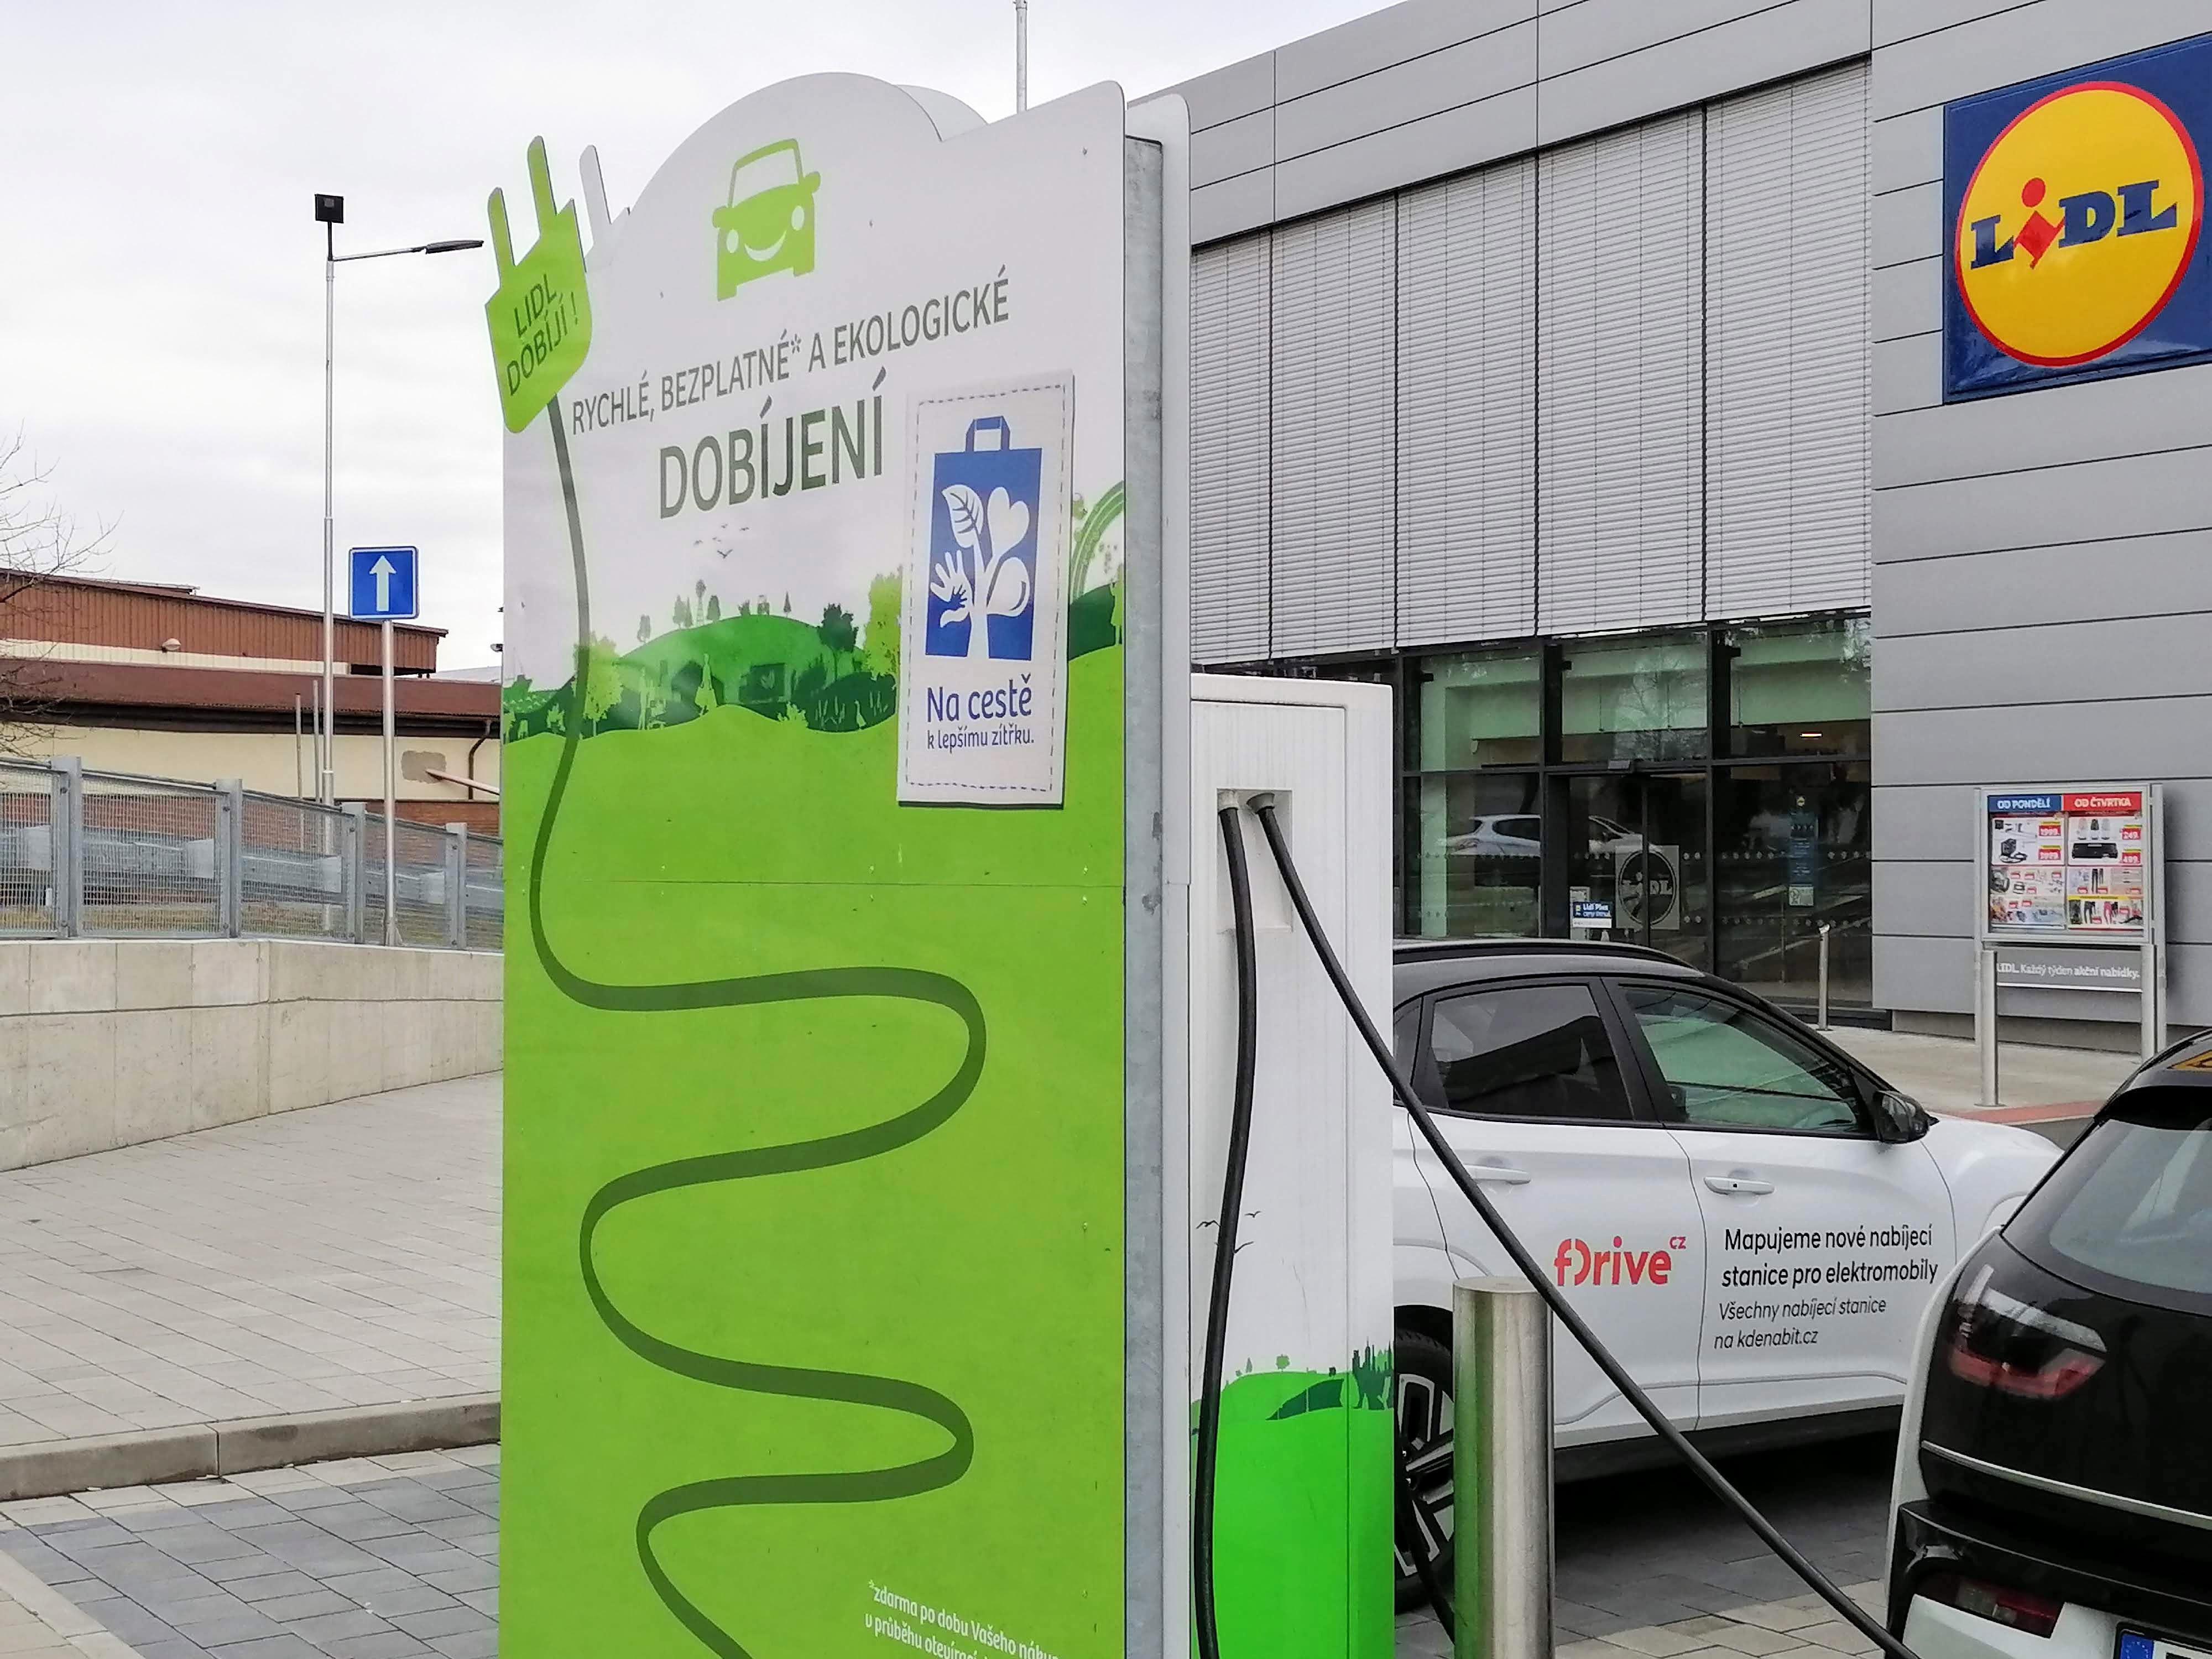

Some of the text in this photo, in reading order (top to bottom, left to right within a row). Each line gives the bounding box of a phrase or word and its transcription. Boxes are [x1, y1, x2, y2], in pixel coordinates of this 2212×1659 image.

[514, 274, 556, 338] LIDL
[573, 370, 655, 435] RYCHLÉ,
[808, 332, 826, 372] A
[834, 264, 1009, 366] EKOLOGICKÉ
[660, 366, 886, 519] DOBÍJENÍ
[927, 672, 1032, 722] Na cestě
[927, 722, 1035, 754] k lepšímu zítřku.
[1997, 800, 2011, 809] OD
[2074, 798, 2089, 807] OD
[1725, 1223, 1933, 1255] Mapujeme nové nabíjecí
[1721, 1258, 1938, 1289] stanice pro elektromobily
[1719, 1295, 1886, 1323] Všechny nabíjecí stanice
[1714, 1327, 1818, 1349] na kdenabit.cz
[875, 1616, 922, 1649] průběhu
[920, 1605, 936, 1625] po
[937, 1608, 968, 1637] dobu
[971, 1620, 1016, 1655] Vašeho
